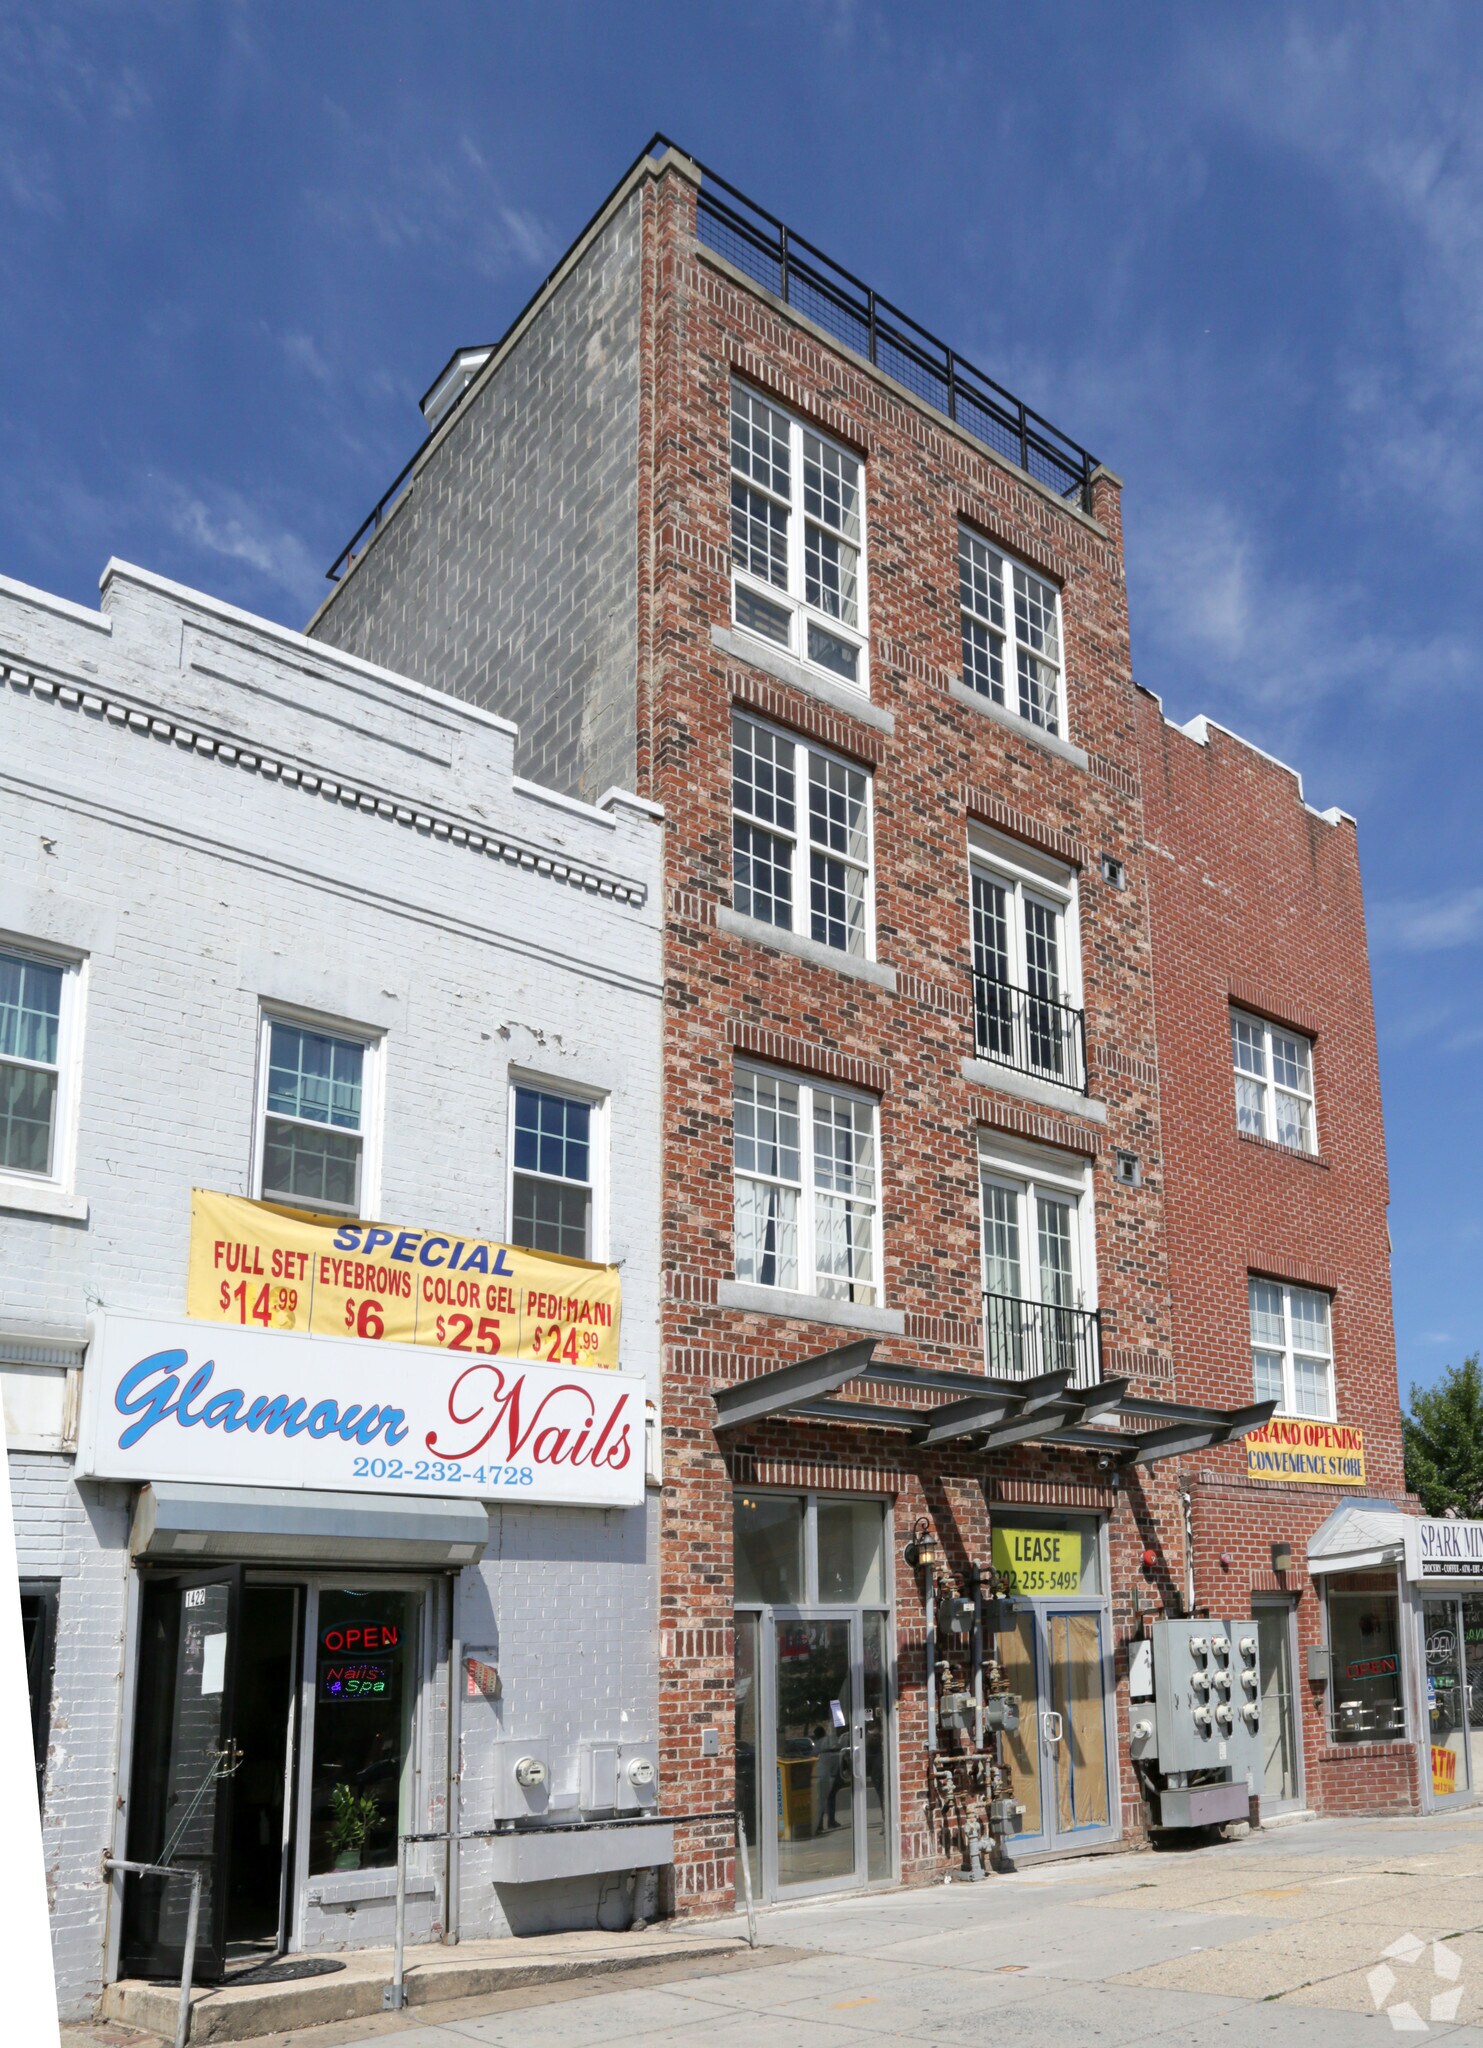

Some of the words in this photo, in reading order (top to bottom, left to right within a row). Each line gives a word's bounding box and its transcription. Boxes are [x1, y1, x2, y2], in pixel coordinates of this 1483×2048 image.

[213, 1240, 265, 1276] FULL
[270, 1248, 309, 1281] SET
[332, 1223, 515, 1278] SPECIAL
[319, 1256, 412, 1299] EYEBROWS
[422, 1275, 481, 1308] COLOR
[486, 1284, 516, 1314] GEL
[114, 1348, 409, 1450] Glamour
[425, 1364, 631, 1470] Nails
[1303, 1424, 1362, 1451] OPENING
[352, 1457, 534, 1486] 202-232-4728
[1248, 1449, 1328, 1475] CONVENIENCE
[1328, 1456, 1363, 1477] STORE
[1014, 1536, 1061, 1563] LEASE
[1421, 1524, 1462, 1557] SPARK
[187, 1589, 205, 1607] 1422
[325, 1625, 398, 1651] OPEN
[1425, 1636, 1454, 1659] OPEN
[326, 1668, 380, 1680] Nails
[1345, 1657, 1396, 1679] OPEN
[331, 1681, 342, 1691] &
[345, 1680, 385, 1694] Spa
[1430, 1747, 1456, 1780] ATM
